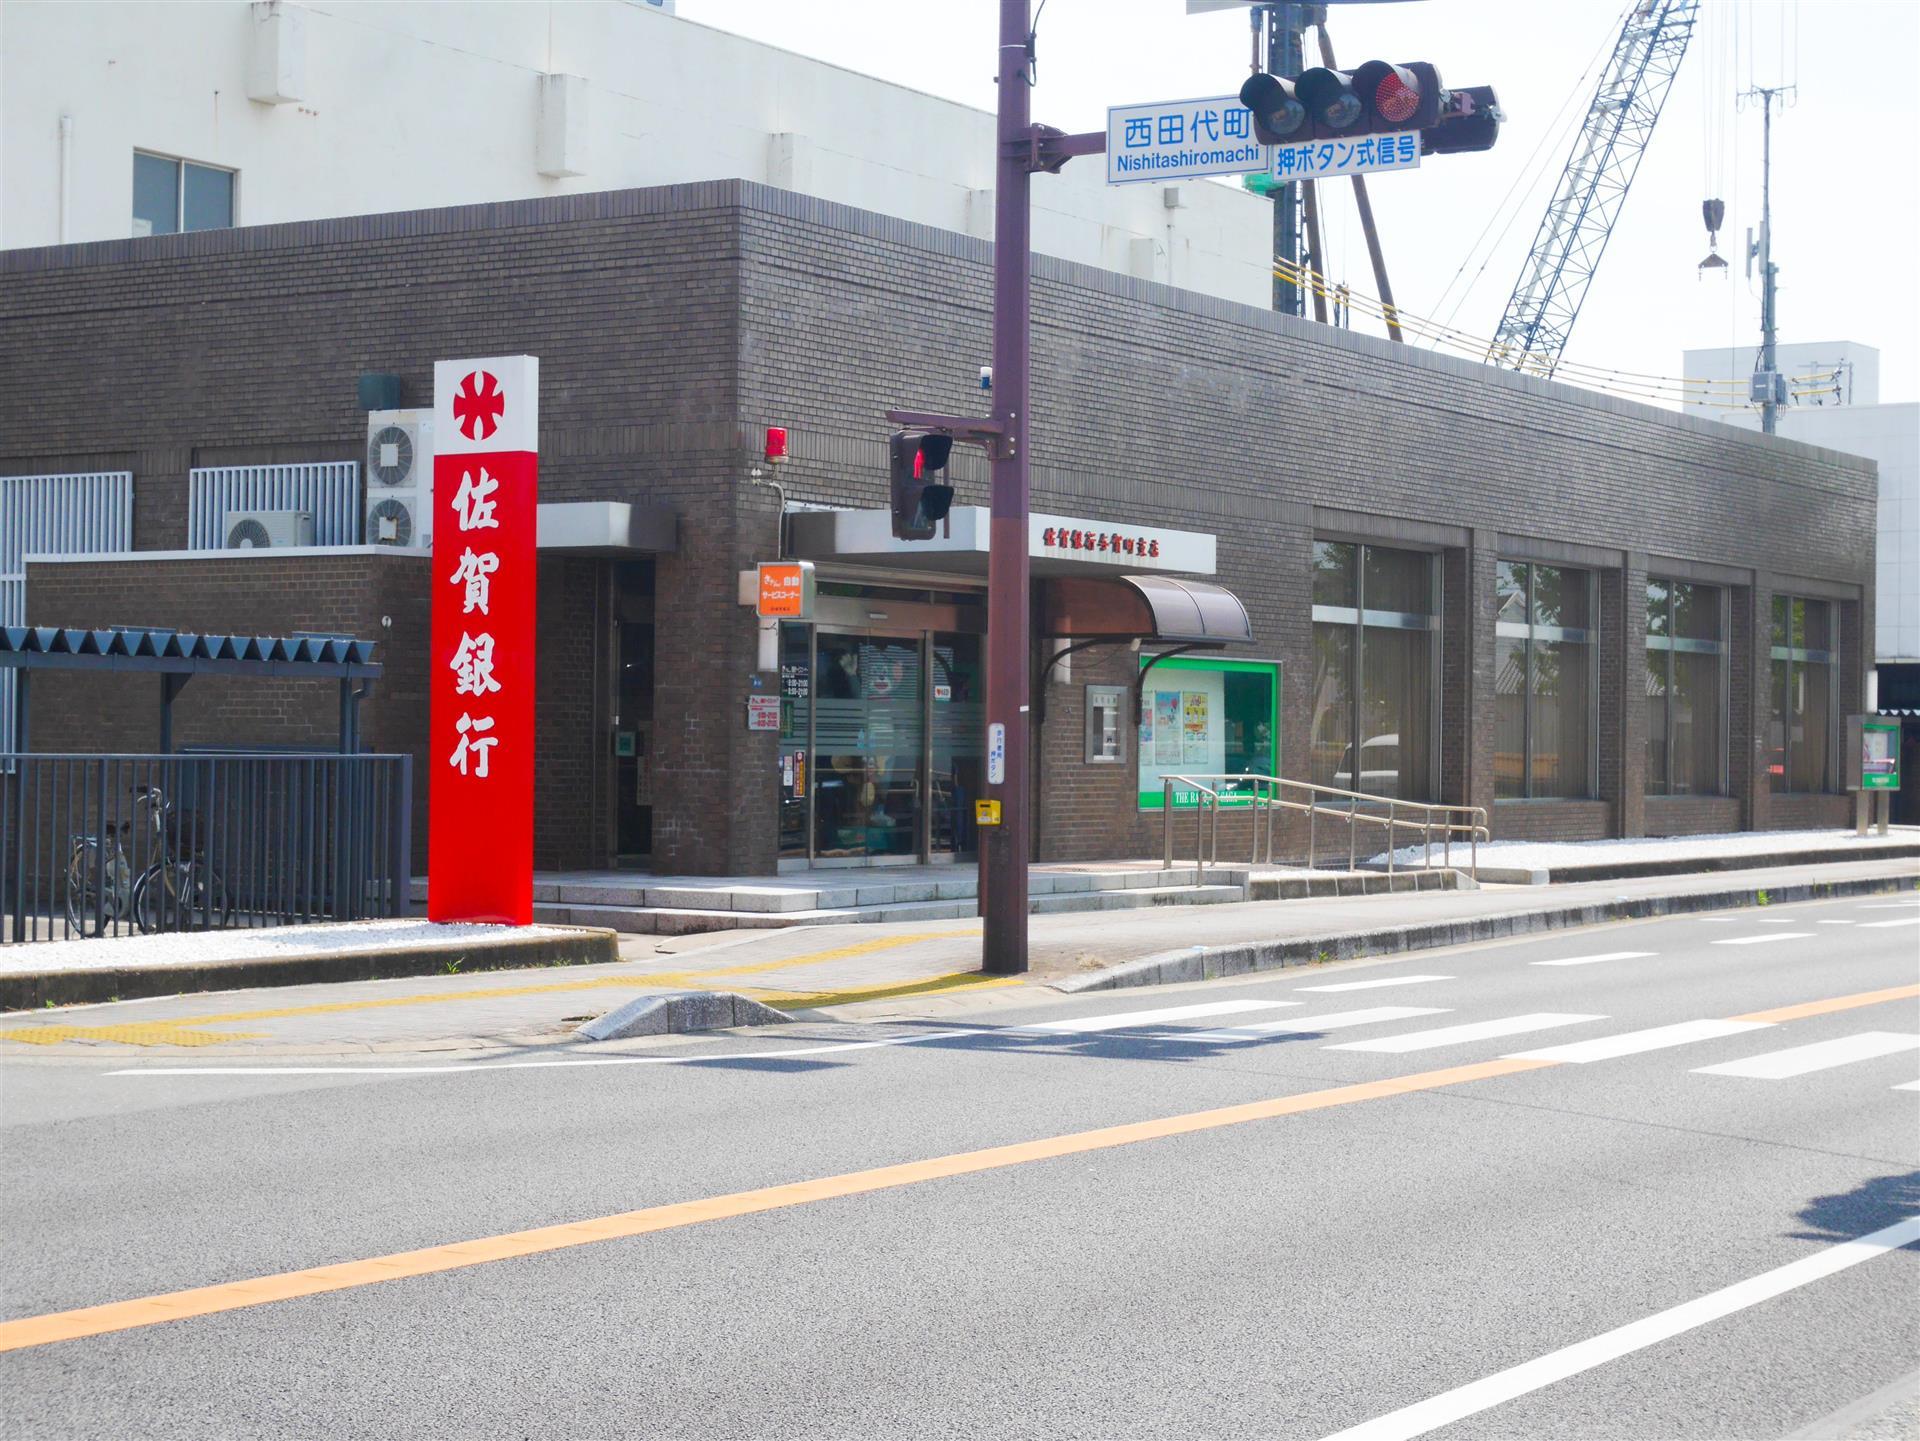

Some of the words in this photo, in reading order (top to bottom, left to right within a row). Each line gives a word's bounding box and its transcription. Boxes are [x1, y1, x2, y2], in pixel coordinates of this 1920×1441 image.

[1125, 108, 1250, 148] 西田代町
[1117, 144, 1259, 172] Nishitashiromachi
[1277, 135, 1416, 175] 押ボタン式信号
[449, 466, 501, 778] 佐賀銀行
[1175, 791, 1189, 803] THE
